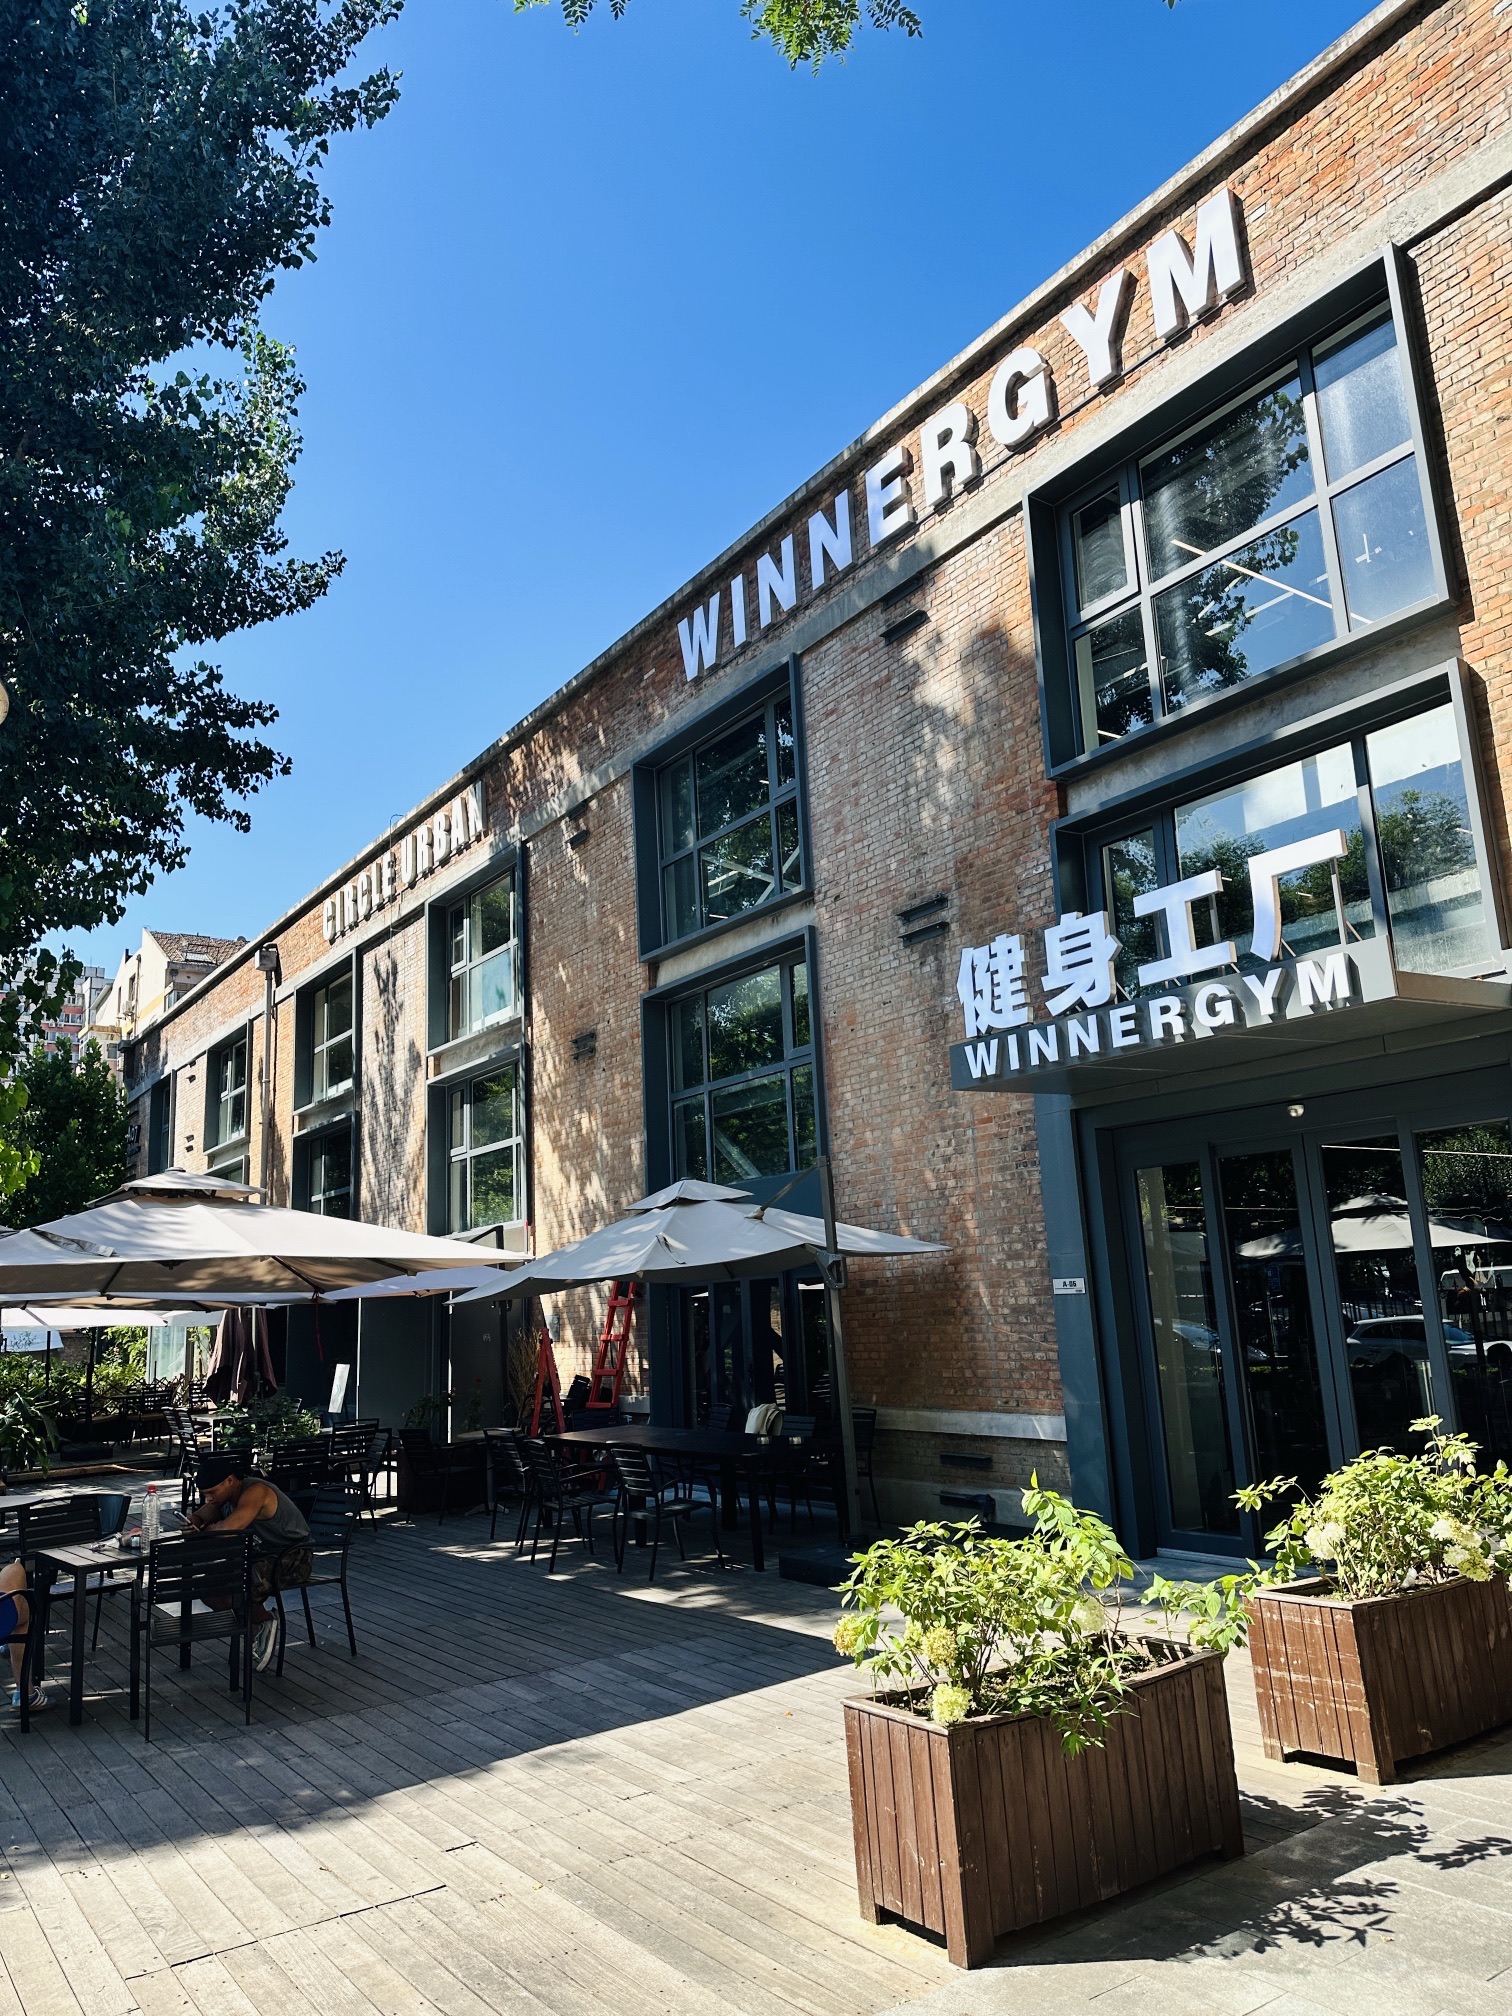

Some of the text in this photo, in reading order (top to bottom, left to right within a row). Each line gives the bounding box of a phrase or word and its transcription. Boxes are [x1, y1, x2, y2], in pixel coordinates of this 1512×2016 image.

[677, 189, 1246, 681] WINNERGYM
[322, 780, 488, 942] CIRCLE URBAN
[957, 828, 1347, 1038] 健身工厂
[964, 953, 1350, 1079] WINNERGYM
